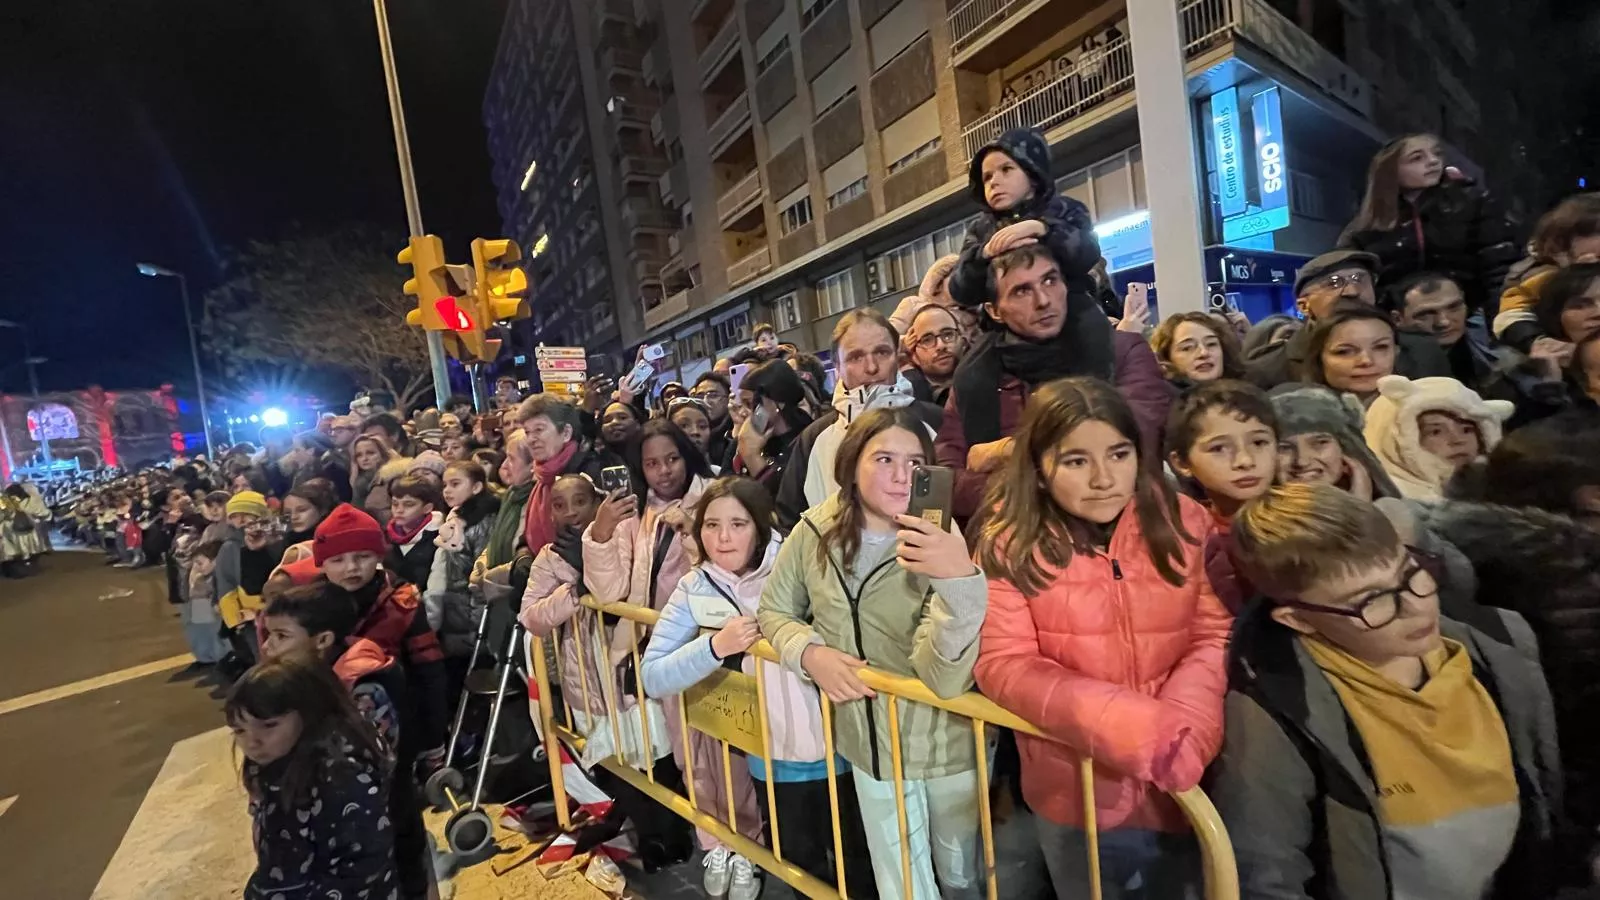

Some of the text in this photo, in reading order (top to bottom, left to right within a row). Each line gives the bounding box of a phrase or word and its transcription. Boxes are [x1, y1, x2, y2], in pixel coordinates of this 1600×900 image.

[1219, 106, 1237, 200] Centro de estudios
[1261, 142, 1282, 194] SCIO
[1231, 264, 1250, 279] MGS
